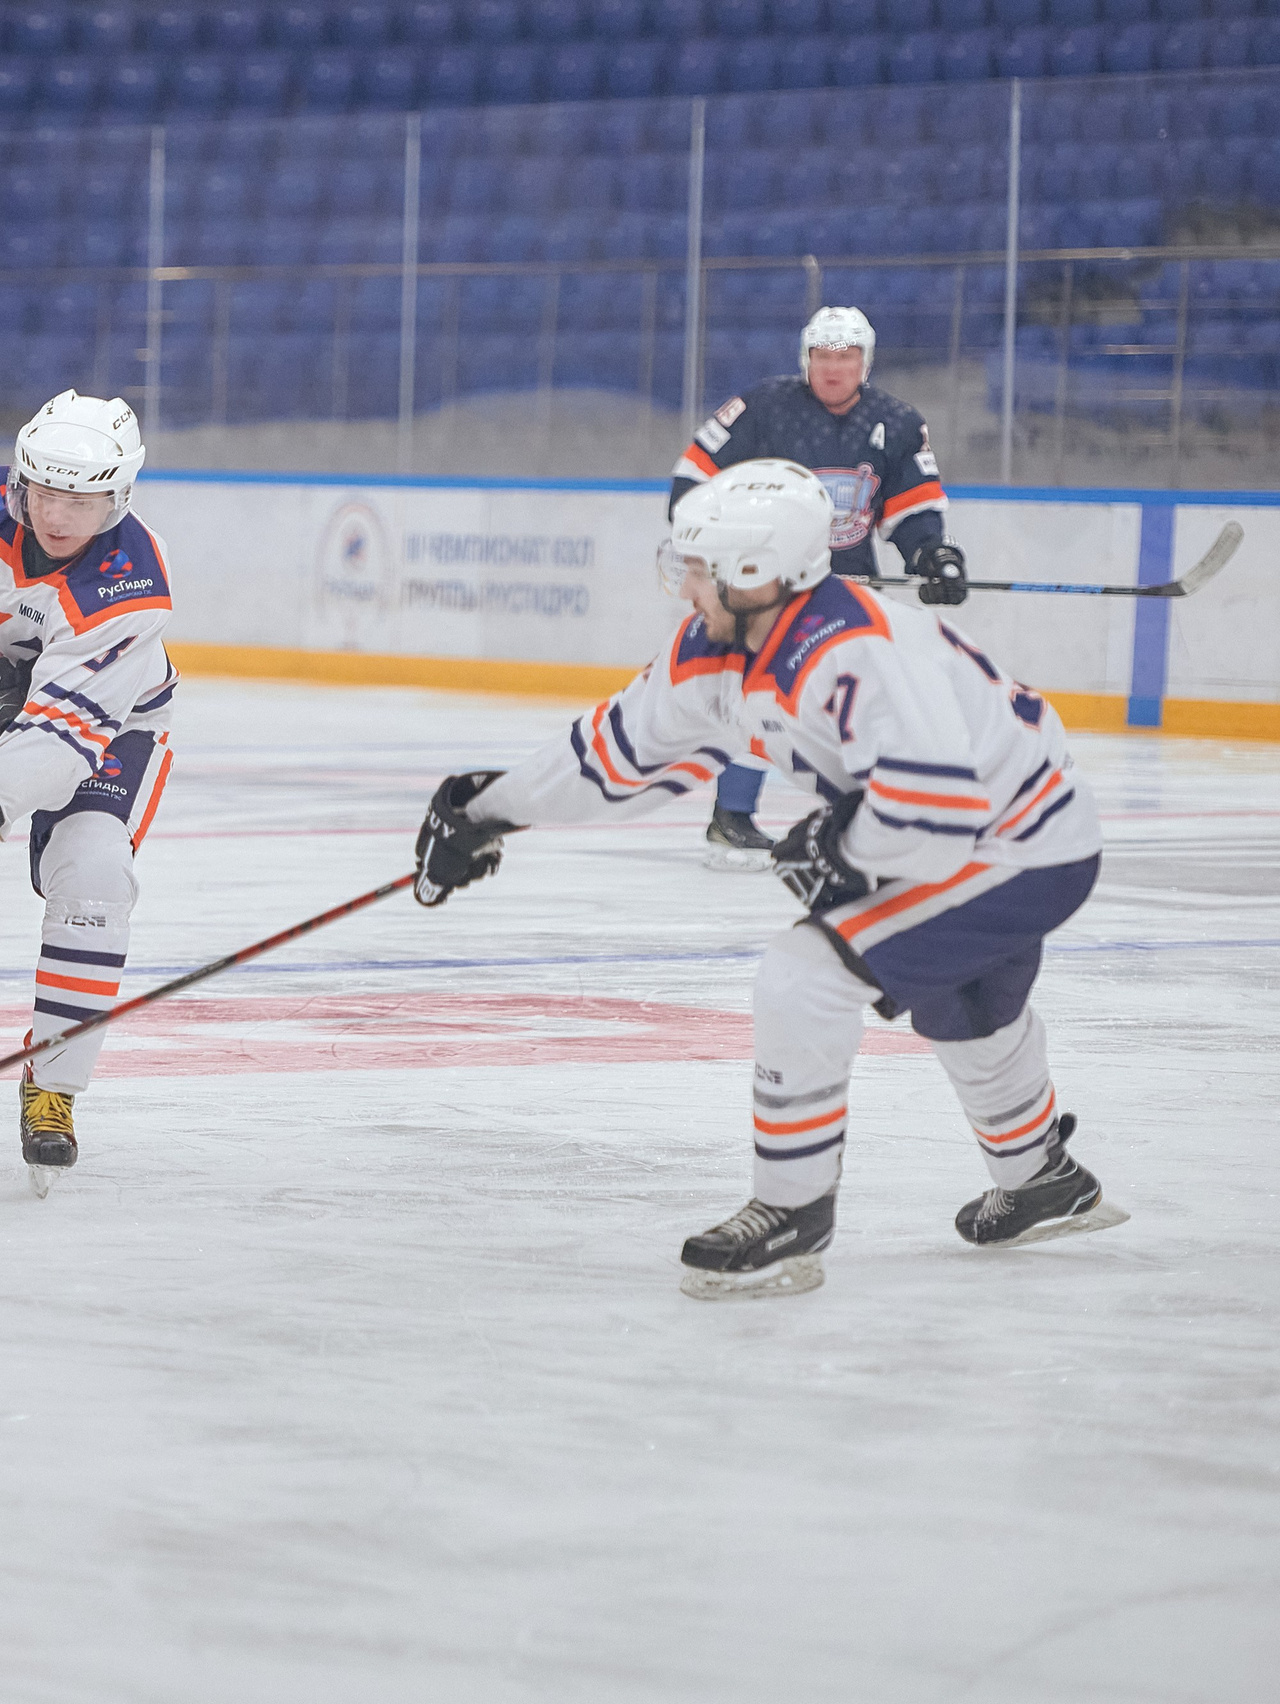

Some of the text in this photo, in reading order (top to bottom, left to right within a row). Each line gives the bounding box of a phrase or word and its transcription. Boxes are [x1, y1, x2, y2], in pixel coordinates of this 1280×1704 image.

[868, 421, 886, 451] A
[45, 465, 80, 477] CCM
[97, 578, 153, 599] РусГидро
